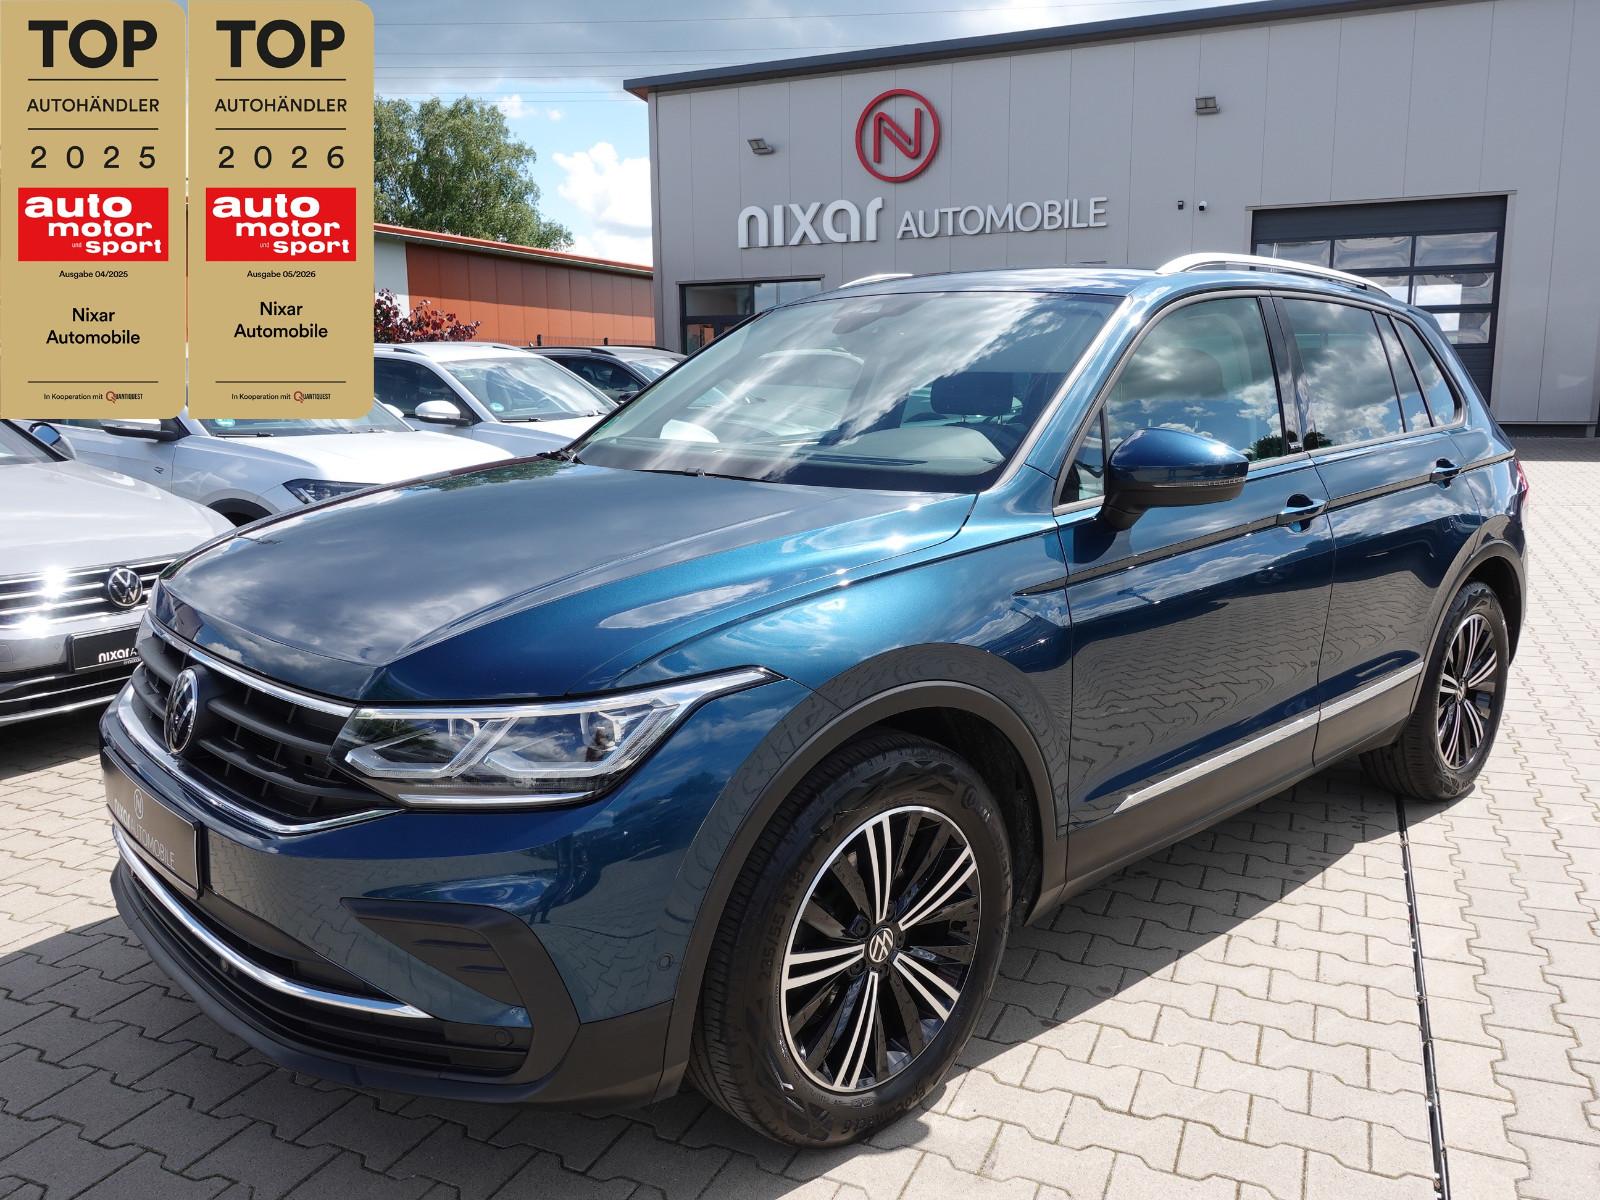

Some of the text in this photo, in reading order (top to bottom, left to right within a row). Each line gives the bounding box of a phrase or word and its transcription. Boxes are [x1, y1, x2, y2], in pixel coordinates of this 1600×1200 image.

[737, 196, 1108, 249] nixar AUTOMOBILE
[98, 648, 130, 663] nixar
